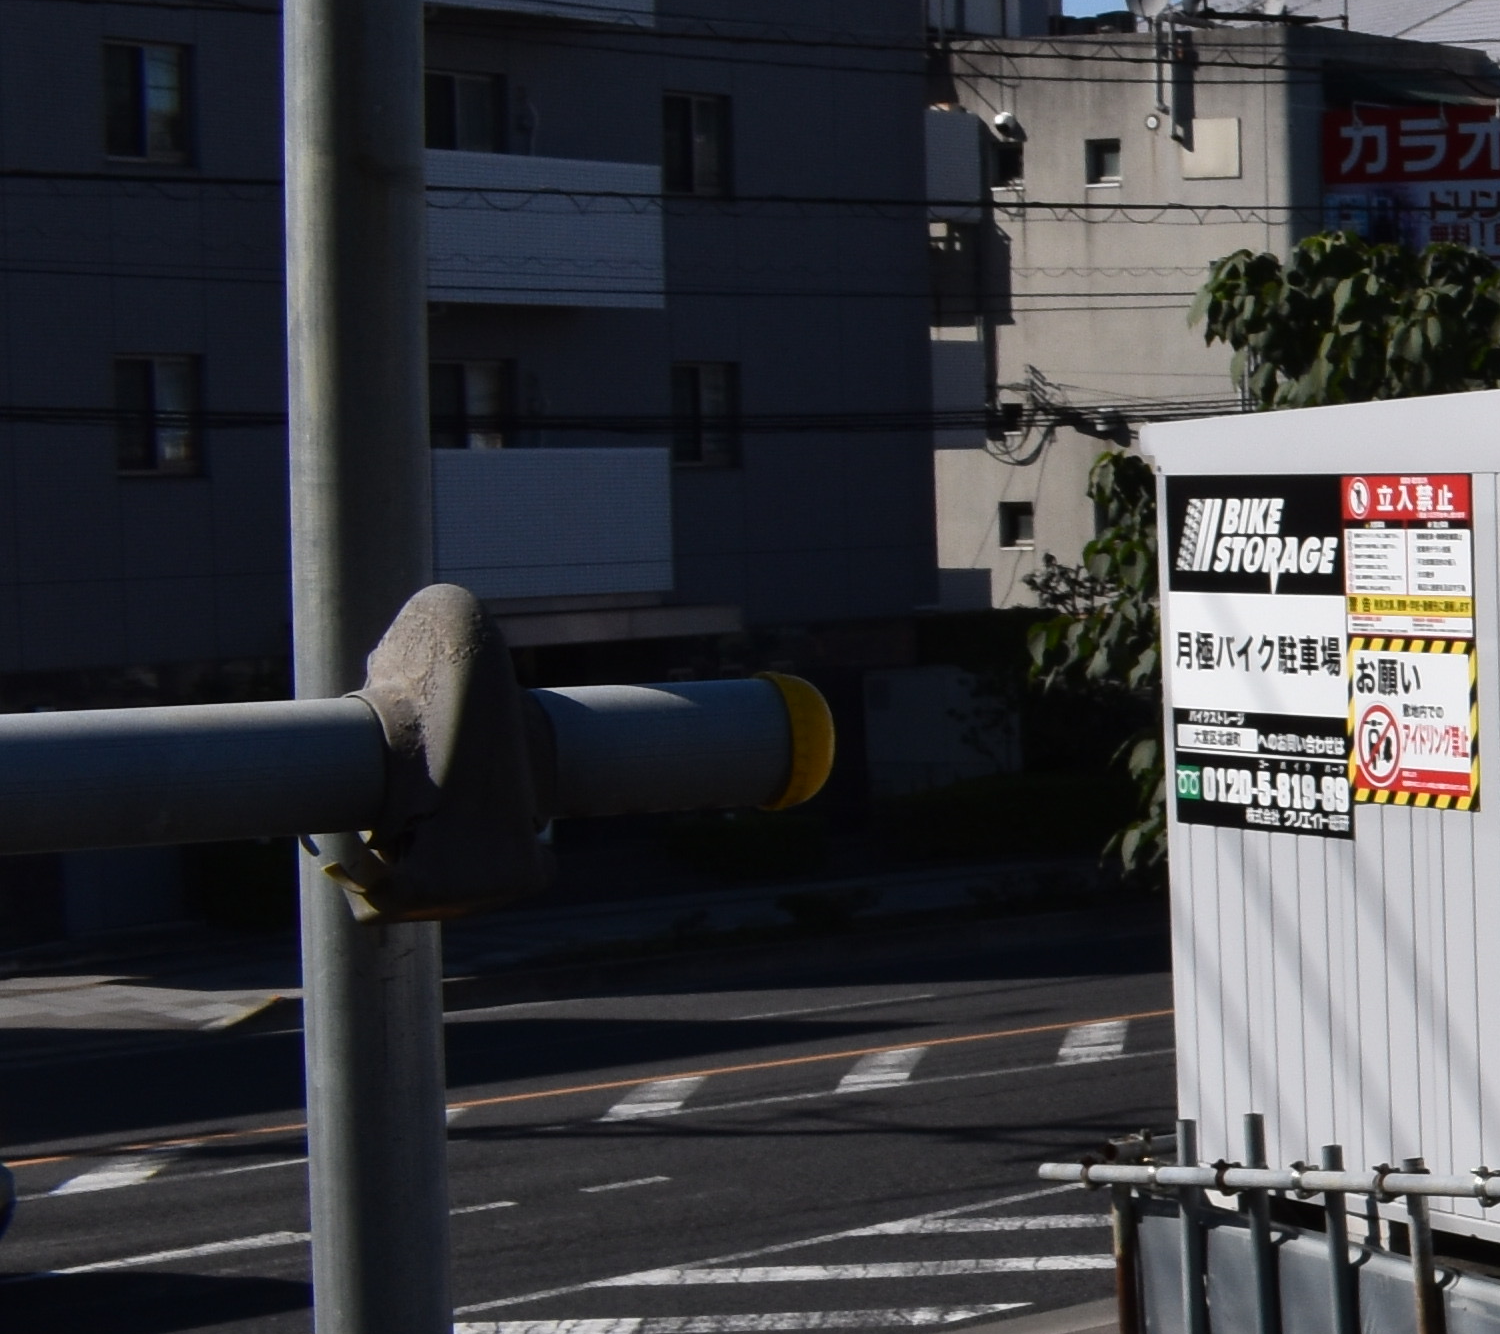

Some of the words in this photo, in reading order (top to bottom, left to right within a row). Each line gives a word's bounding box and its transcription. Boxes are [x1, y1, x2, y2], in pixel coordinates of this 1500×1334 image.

[1221, 498, 1285, 535] BIKE
[1376, 484, 1454, 512] 立入禁止
[1213, 536, 1339, 595] STORAGE
[1176, 631, 1342, 676] 月極バイク駐車場
[1356, 657, 1422, 696] お願い
[1188, 710, 1246, 726] バイクストレージ
[1258, 733, 1346, 756] へのお問い合わせは
[1403, 724, 1470, 759] アイドリング禁止
[1202, 766, 1349, 814] 0120-5-819-89
